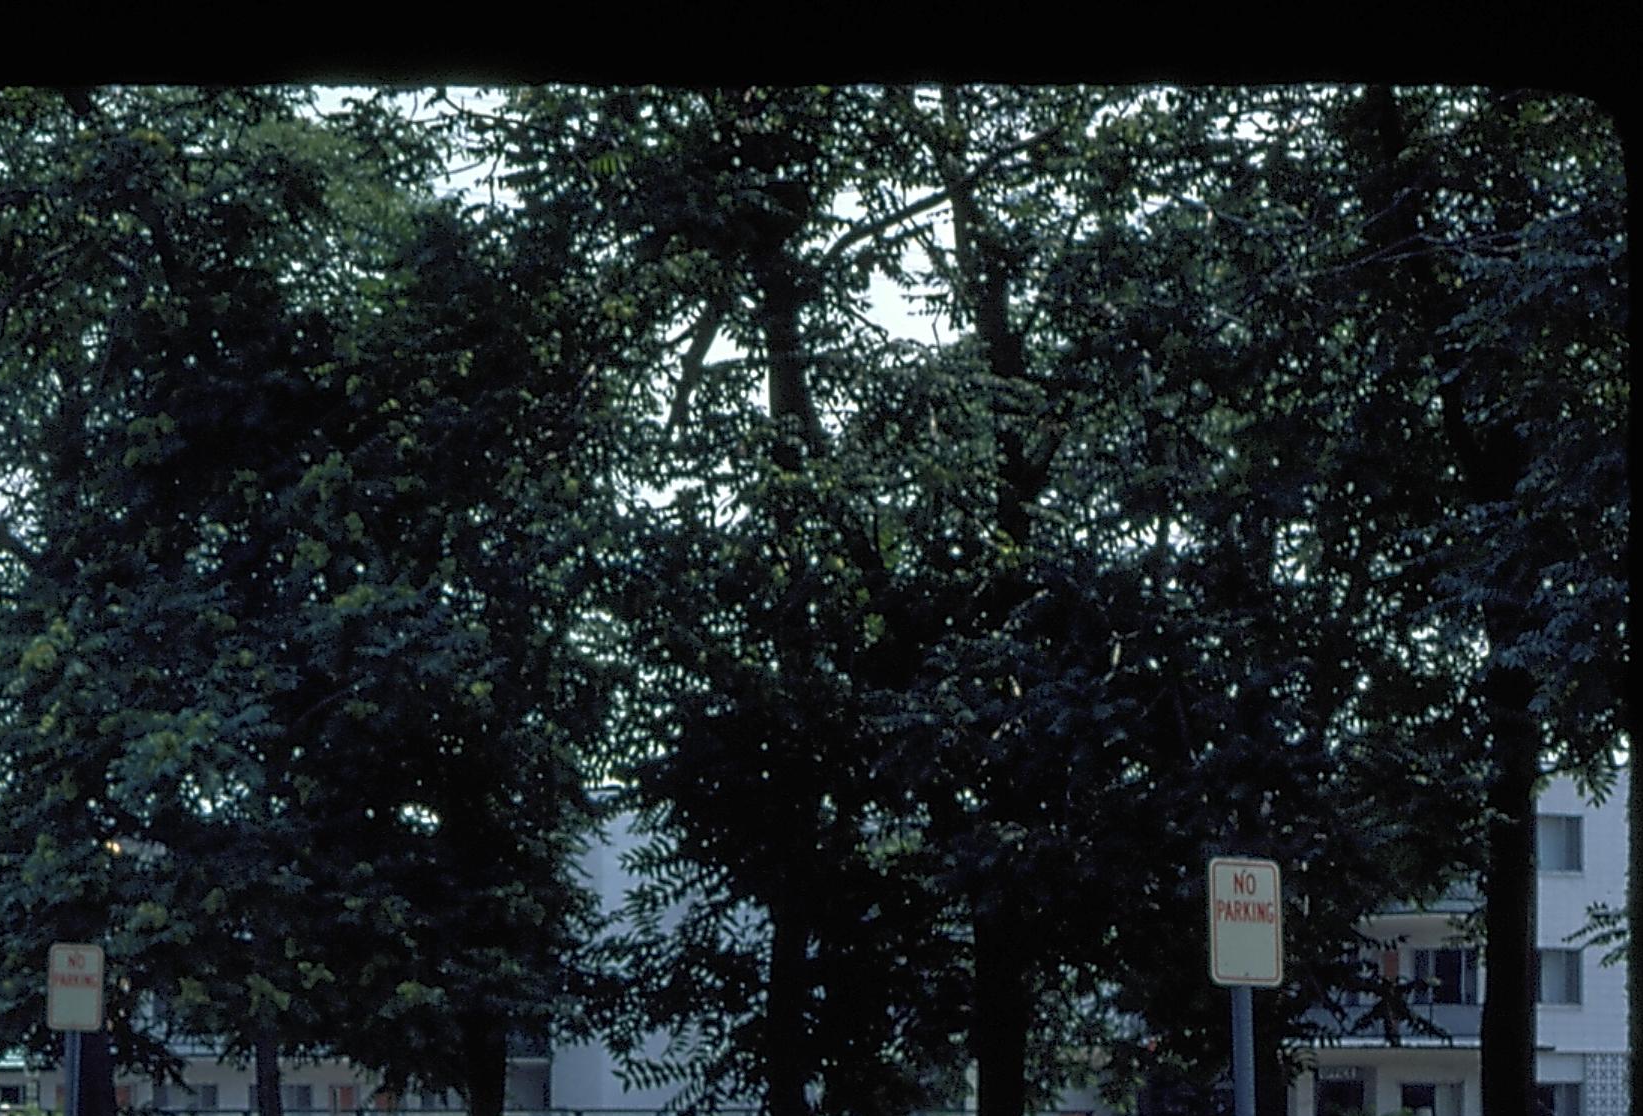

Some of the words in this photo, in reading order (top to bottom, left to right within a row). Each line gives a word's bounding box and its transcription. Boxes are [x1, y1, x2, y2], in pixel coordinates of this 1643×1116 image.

[1234, 872, 1257, 895] NO
[1216, 899, 1275, 925] PARKING
[68, 953, 86, 969] NO
[52, 974, 99, 987] PARKING
